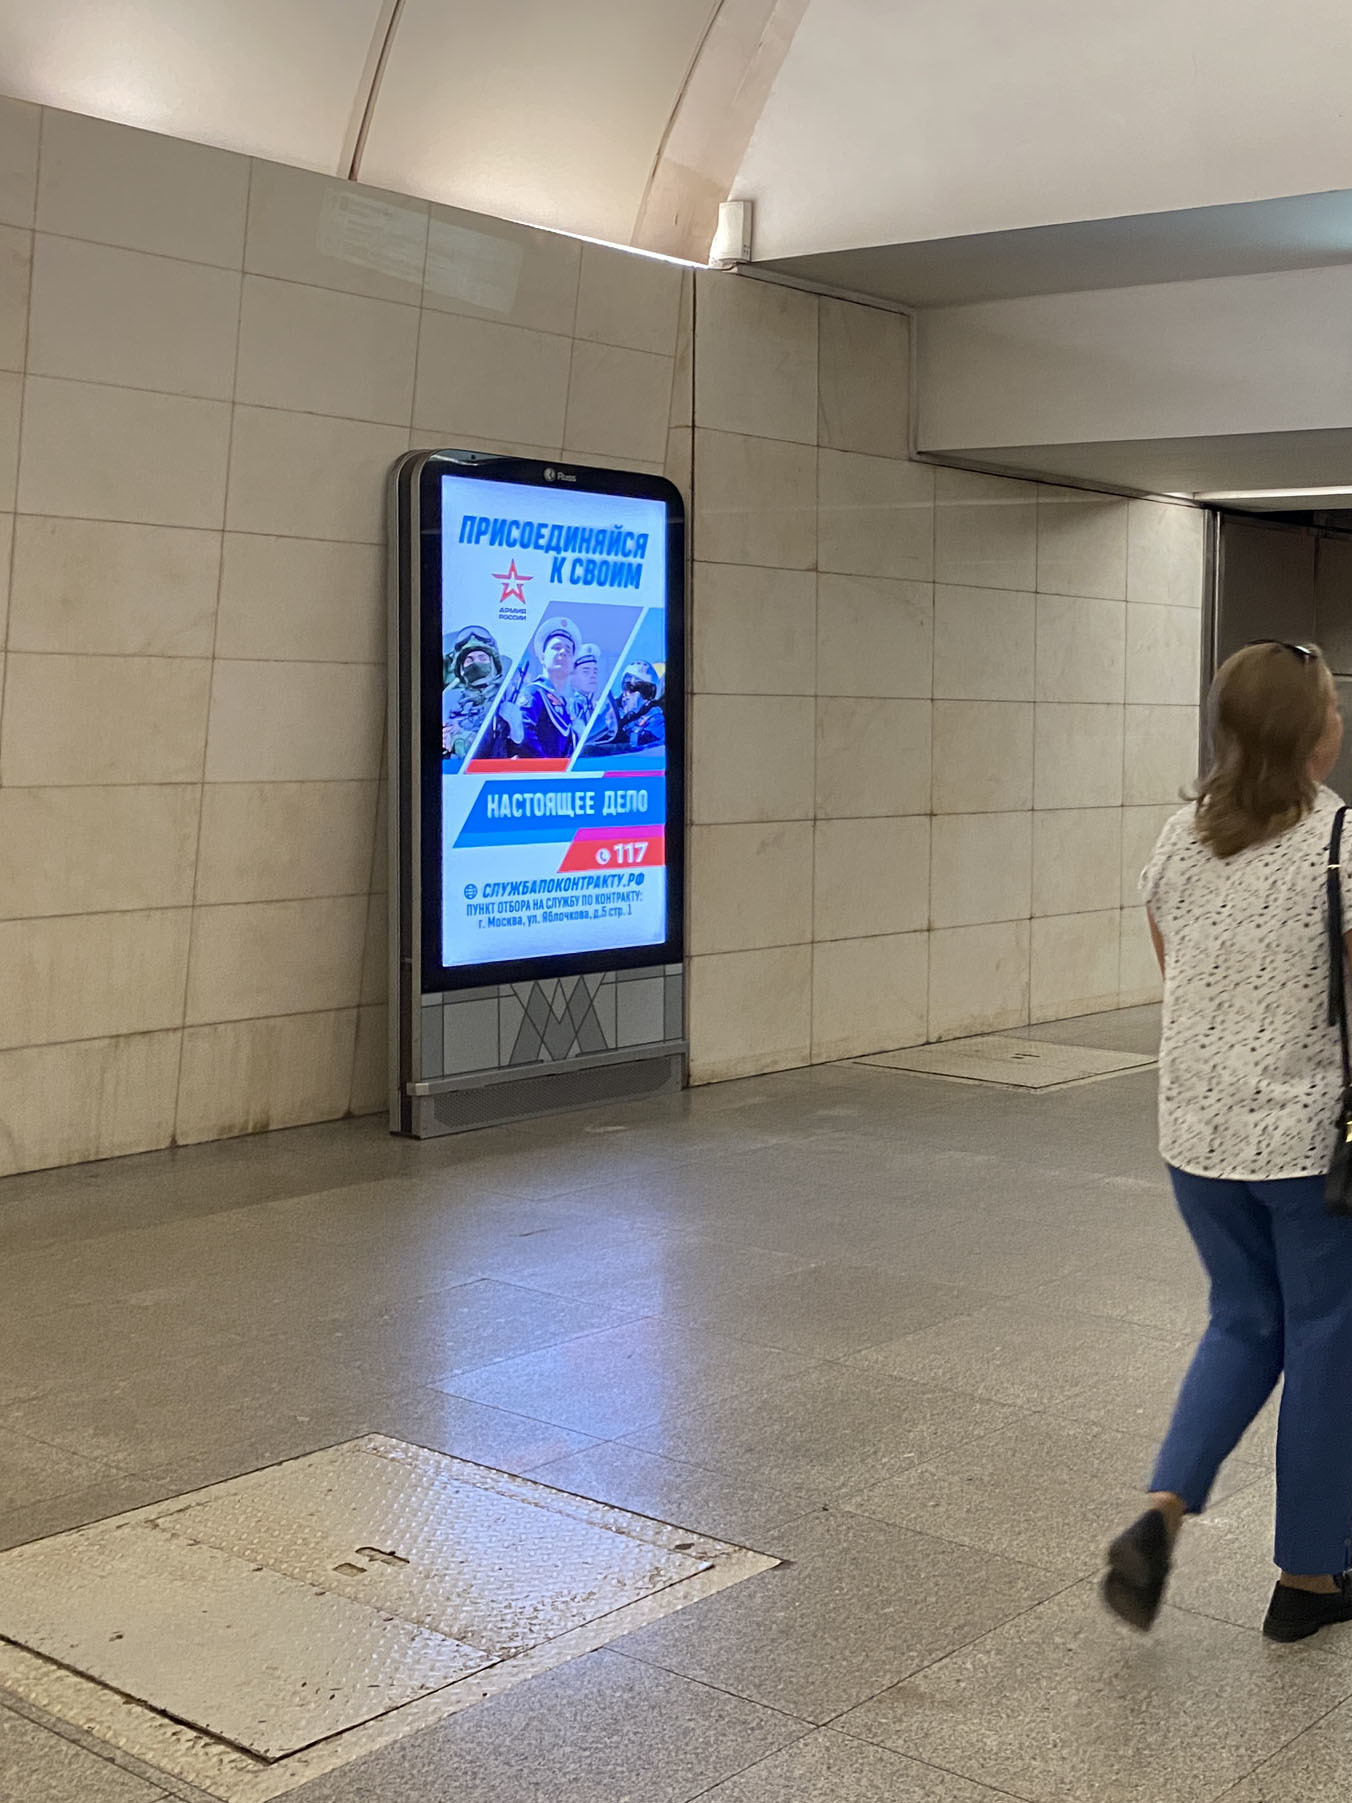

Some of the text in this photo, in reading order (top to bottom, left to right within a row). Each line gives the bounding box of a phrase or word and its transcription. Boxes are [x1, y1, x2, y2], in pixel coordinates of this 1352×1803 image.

[458, 514, 649, 560] ПРИСОЕДИНЯЙСЯ
[550, 557, 643, 590] К СВОИМ
[487, 789, 648, 818] НАСТОЯЩЕЕ ДЕЛО
[613, 841, 648, 864] 117
[482, 872, 645, 898] СЛУЖБАПОКОНТРАКТУ.РФ
[466, 890, 643, 917] ПУНКТ ОТБОРА НА СЛУЖБУ ПО КОНТРАКТУ:
[487, 915, 525, 928] Москва,
[527, 914, 541, 928] ул.
[627, 903, 632, 915] 1
